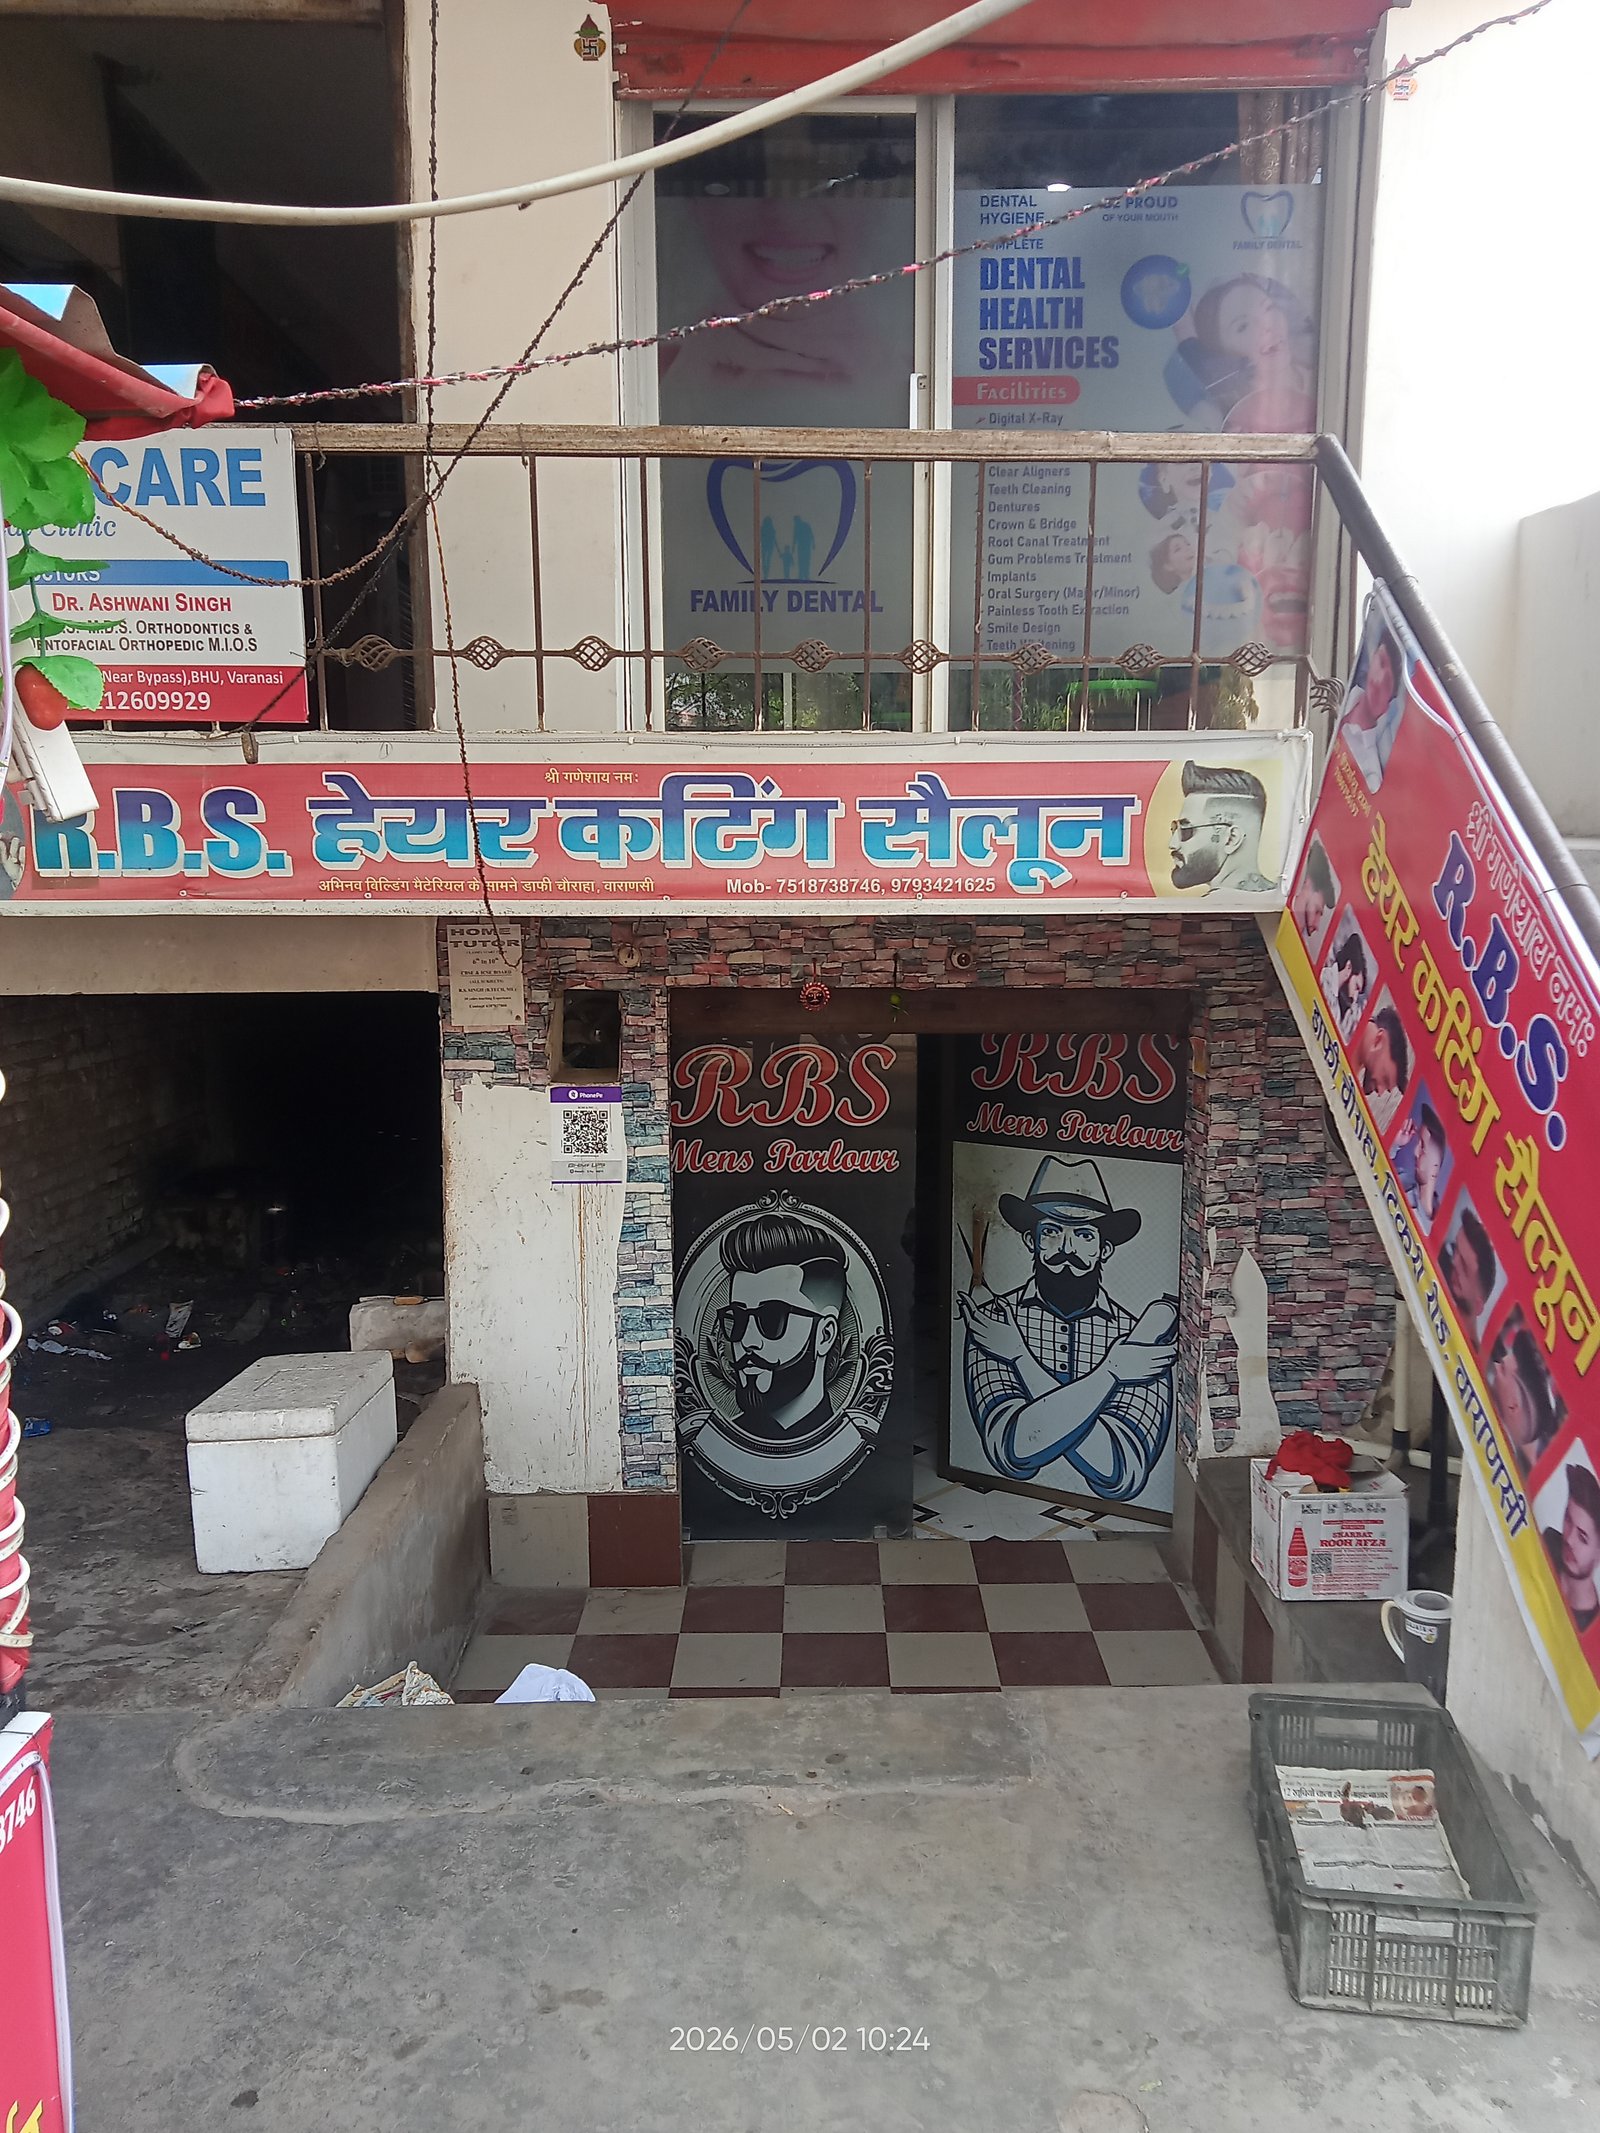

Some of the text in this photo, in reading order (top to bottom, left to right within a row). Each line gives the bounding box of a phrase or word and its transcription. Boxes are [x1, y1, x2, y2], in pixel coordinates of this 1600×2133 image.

[980, 194, 1037, 208] DENTAL
[1126, 196, 1178, 208] PROUD
[980, 212, 1045, 225] HYGIENE
[1102, 214, 1115, 222] OF
[1118, 214, 1142, 222] YOUR
[985, 238, 1044, 250] MPLETE
[979, 257, 1085, 291] DENTAL
[979, 296, 1085, 331] HEALTH
[978, 335, 1120, 371] SERVICES
[989, 412, 1064, 427] Digital X-Ray
[90, 446, 266, 507] CARE
[988, 465, 1071, 480] Clear Aligners
[988, 483, 1072, 497] Teeth Cleaning
[988, 501, 1040, 513] Dentures
[988, 518, 1077, 532] Crown & Bridge
[988, 536, 1014, 548] Root
[1017, 535, 1049, 548] Canal
[988, 552, 1132, 565] Gum Problems Tratment
[987, 571, 1037, 585] Implants
[690, 590, 884, 613] FAMILY DENTAL
[987, 586, 1141, 602] Oral Surgery (Mar/Minor)
[987, 604, 1130, 617] Painless Tooth Exraction
[244, 623, 253, 635] &
[987, 622, 1061, 636] Smile Design
[208, 637, 258, 652] M.I.O.S
[987, 639, 1076, 653] Teeth tening
[228, 669, 284, 685] Varanasi
[80, 691, 211, 710] 12609929
[544, 767, 560, 784] श्री
[562, 768, 611, 784] गणेशाय
[31, 786, 293, 878] R.B.S.
[306, 770, 1141, 894] हेयर कटिंग सैलून
[318, 876, 363, 892] अभिनव
[467, 876, 481, 892] के
[485, 876, 518, 892] सामने
[521, 876, 552, 892] डाफी
[602, 876, 655, 892] वाराणसी
[726, 877, 996, 895] Mob- 7518738746, 9793421625
[450, 927, 512, 936] HOME
[449, 939, 521, 948] TUTOR
[1432, 829, 1568, 1151] R.B.S.
[970, 1032, 1181, 1105] RBS
[671, 1042, 898, 1129] RBS
[1361, 811, 1600, 1377] हेयर कटिंग सैलून
[966, 1101, 1186, 1152] Mens Parlour
[671, 1137, 901, 1174] Mens Parlour
[1355, 1539, 1387, 1548] AFZA
